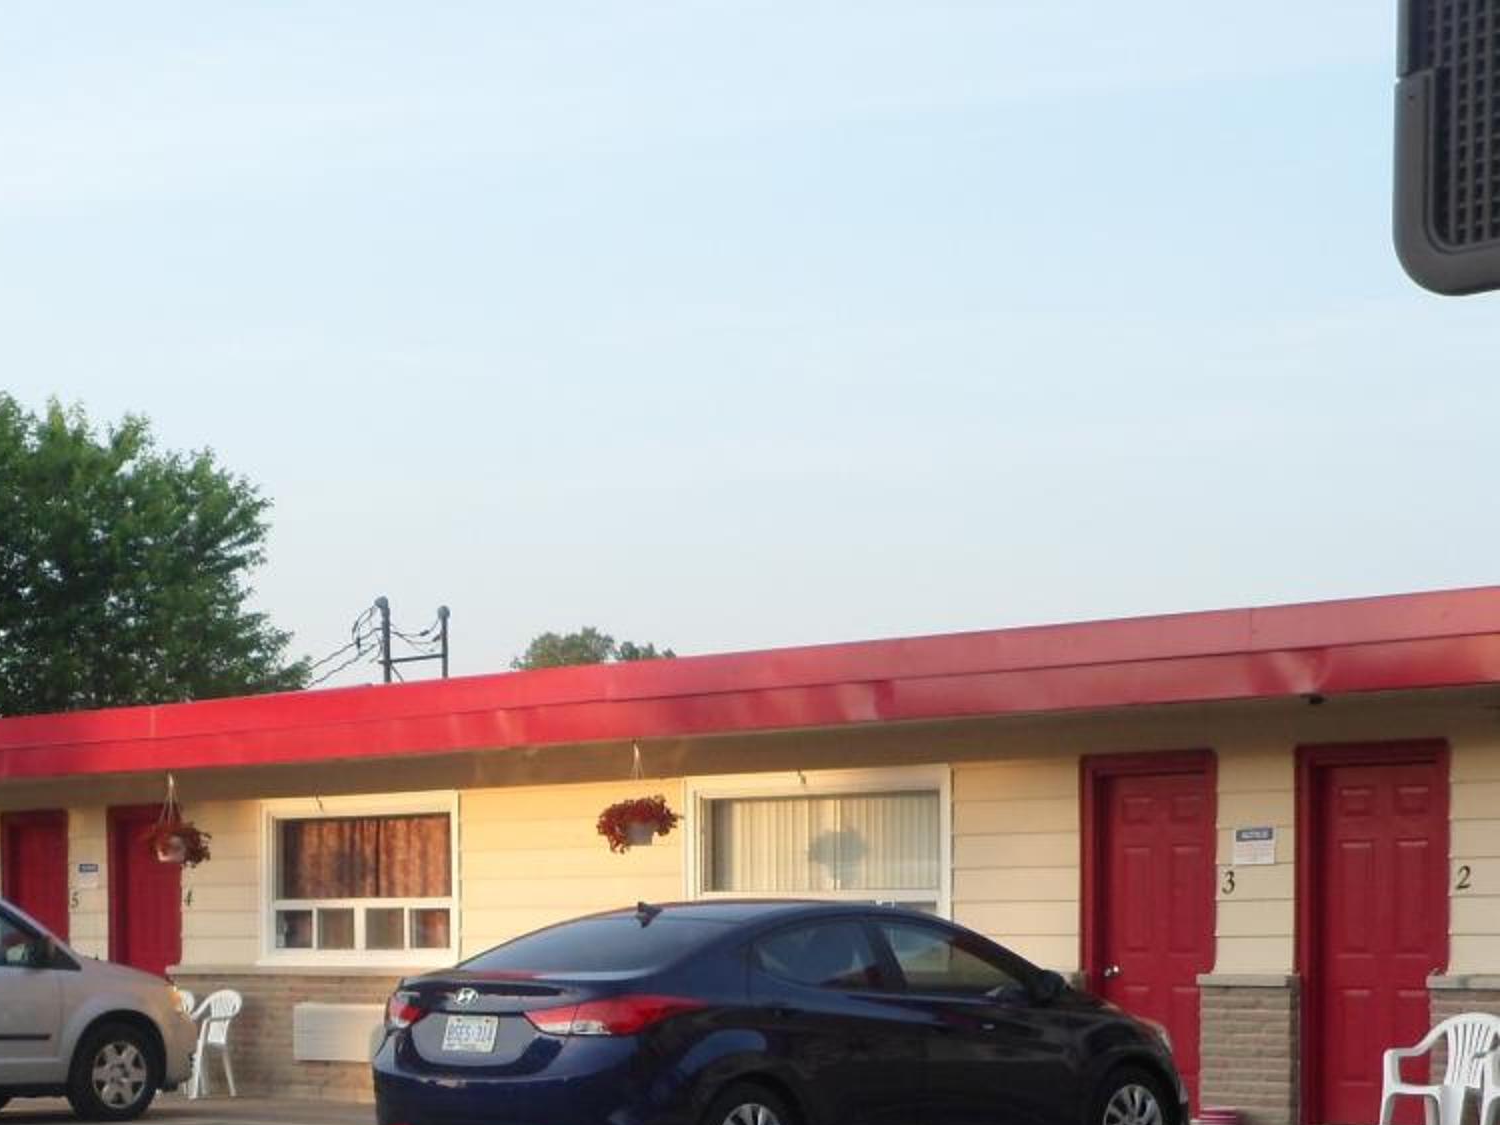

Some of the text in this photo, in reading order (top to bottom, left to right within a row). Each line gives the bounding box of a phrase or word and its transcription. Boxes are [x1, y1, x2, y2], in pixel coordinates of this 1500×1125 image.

[1221, 870, 1235, 894] 3
[1456, 865, 1471, 890] 2
[71, 891, 79, 908] 5
